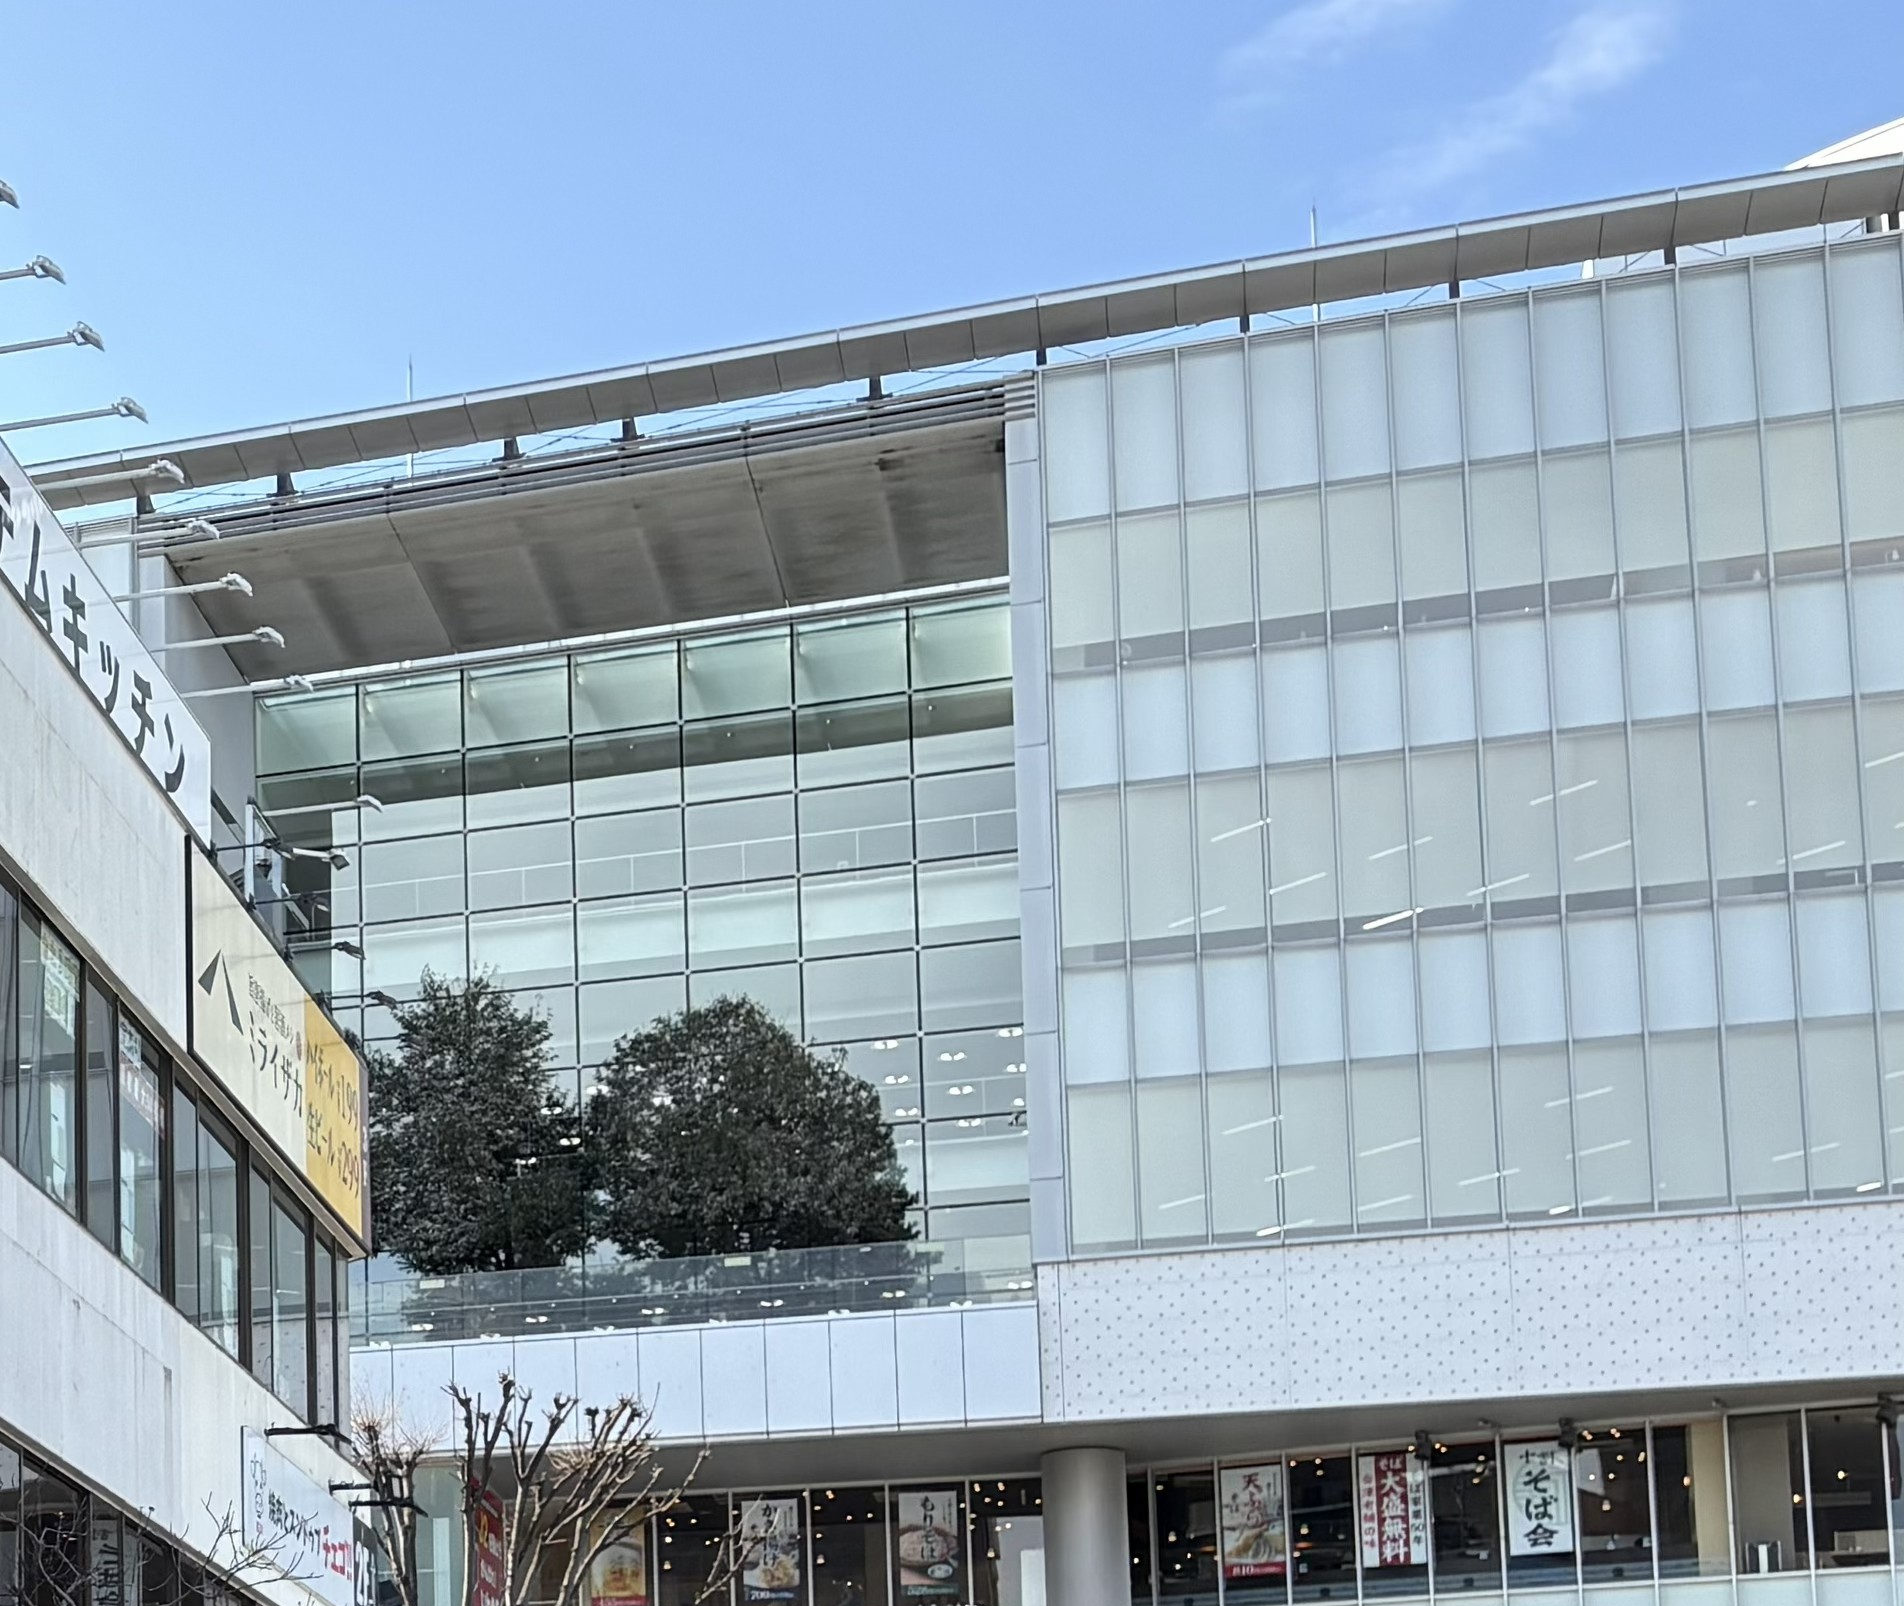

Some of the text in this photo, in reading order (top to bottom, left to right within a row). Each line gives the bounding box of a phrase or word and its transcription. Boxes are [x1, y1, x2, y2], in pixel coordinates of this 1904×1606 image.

[249, 1010, 303, 1118] ミライザカ
[1380, 1470, 1409, 1563] 大盛無料
